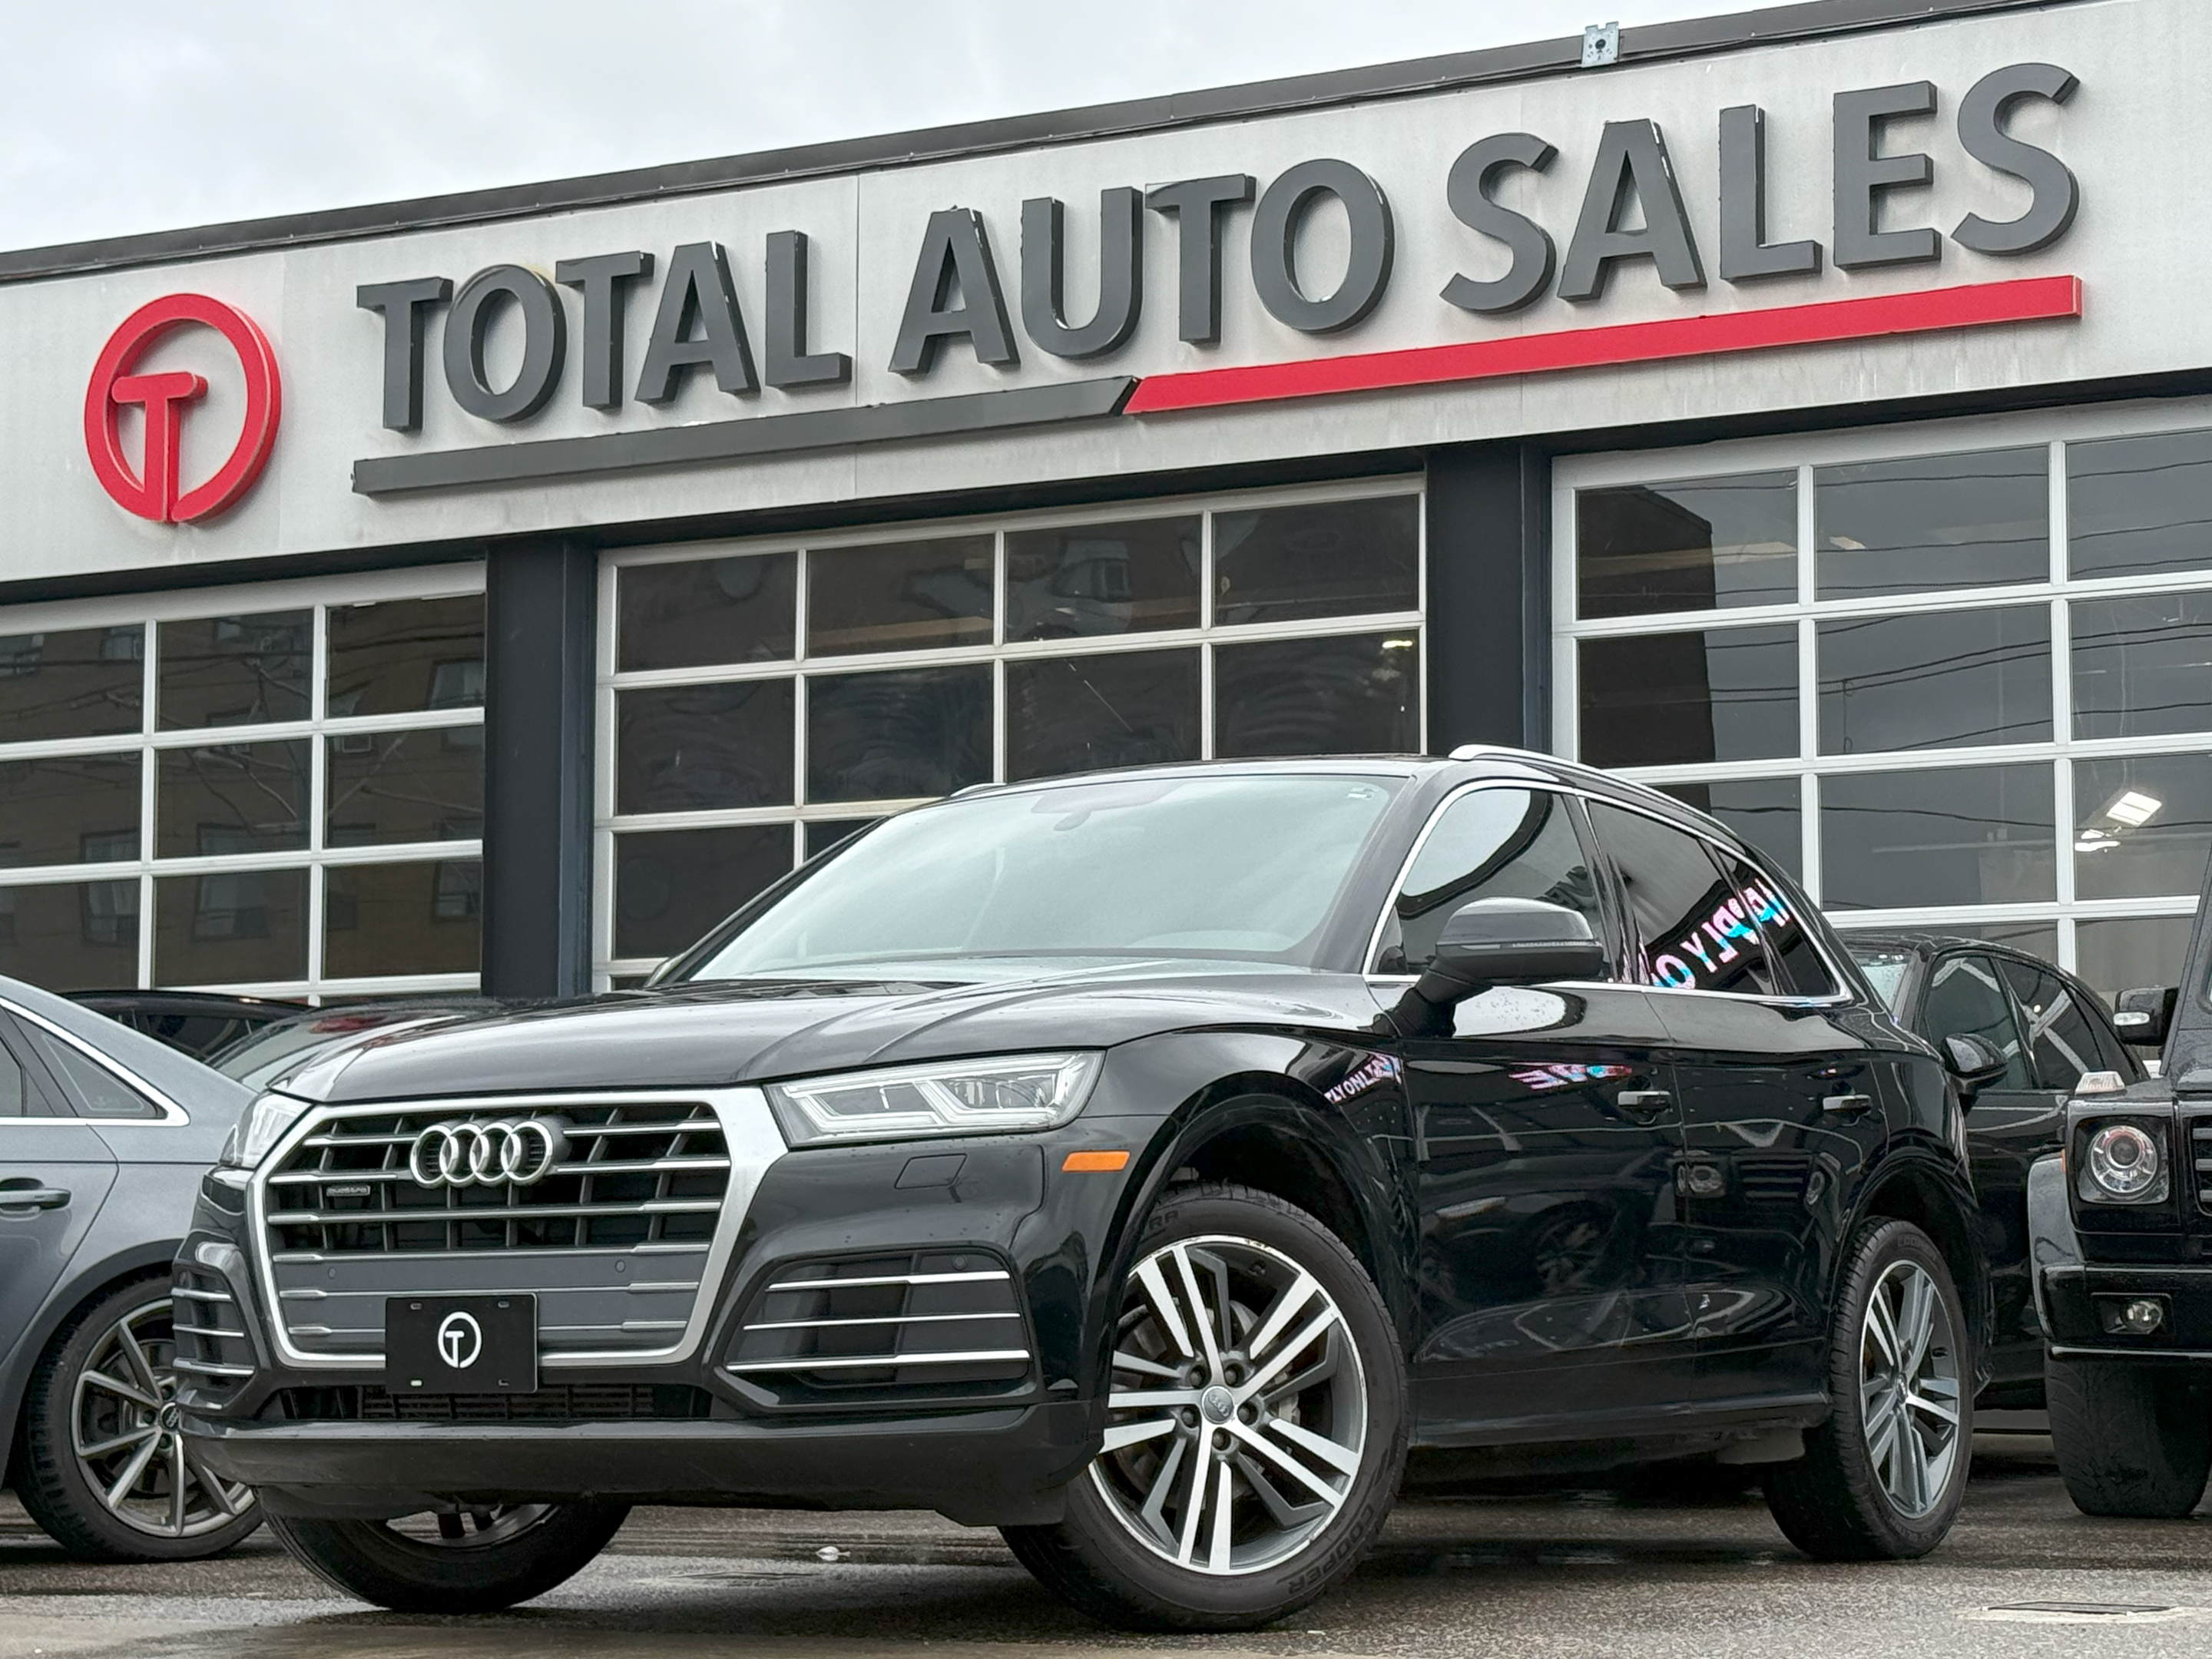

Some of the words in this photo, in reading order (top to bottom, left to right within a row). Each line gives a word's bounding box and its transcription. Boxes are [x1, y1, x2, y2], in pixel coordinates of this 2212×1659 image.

[357, 230, 852, 432] TOTAL
[889, 158, 1395, 374] AUTO
[1439, 63, 2081, 313] SALES
[1288, 1503, 1375, 1594] COOPER
